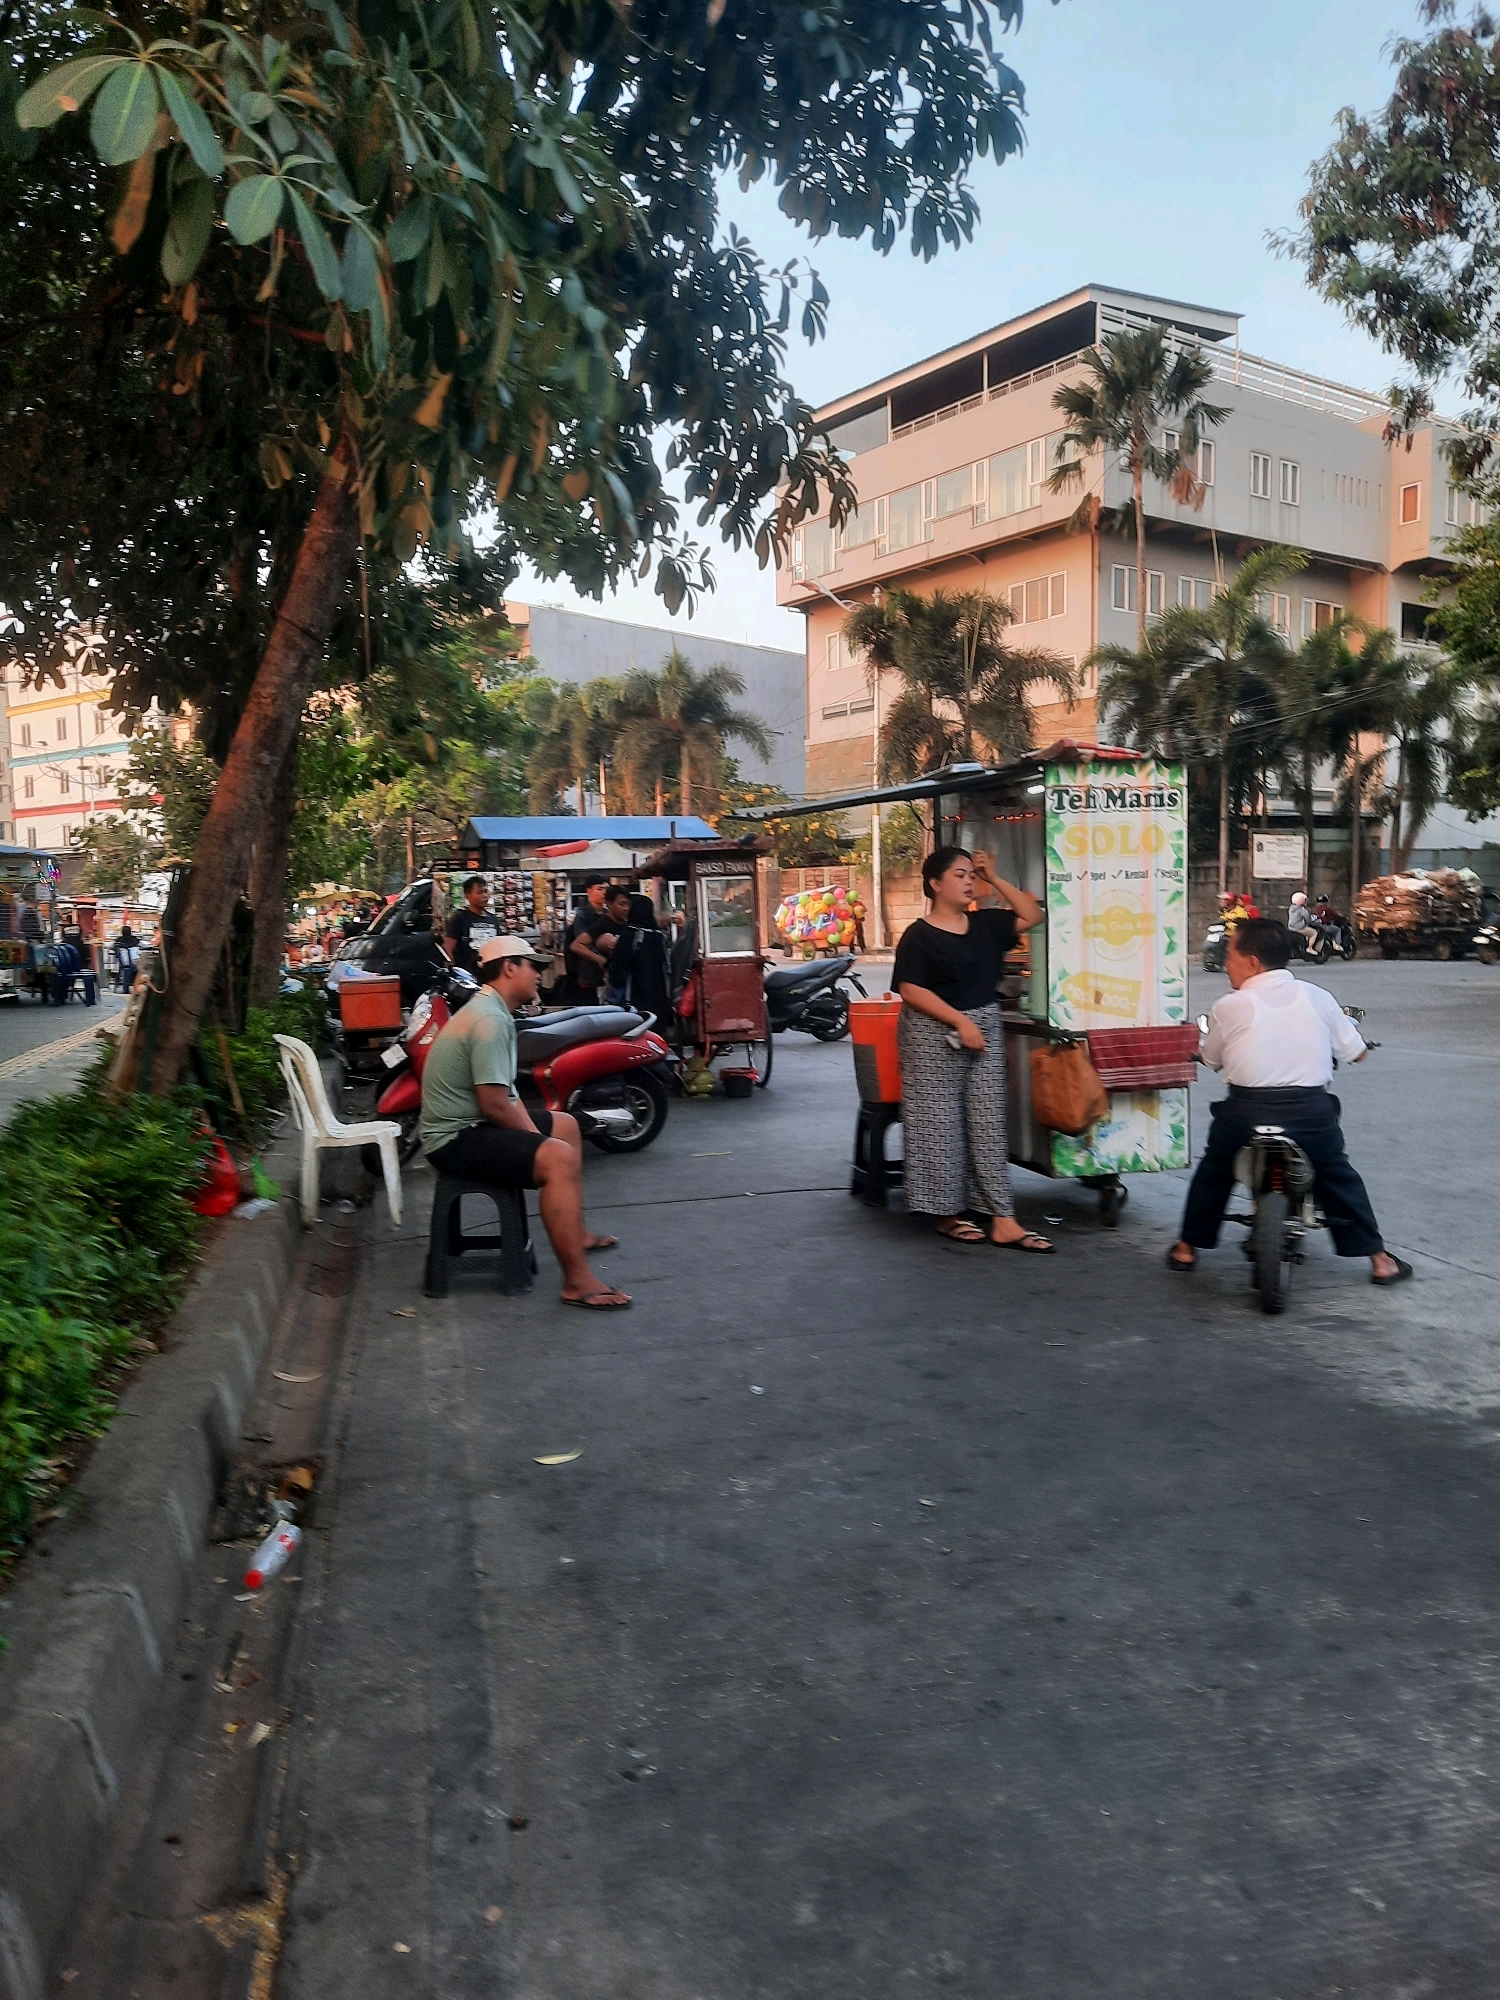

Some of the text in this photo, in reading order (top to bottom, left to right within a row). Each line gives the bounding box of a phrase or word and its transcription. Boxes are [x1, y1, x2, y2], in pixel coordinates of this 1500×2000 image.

[1051, 787, 1180, 810] Teh Manis
[1063, 822, 1166, 857] SOLO
[695, 862, 724, 874] BAKSO
